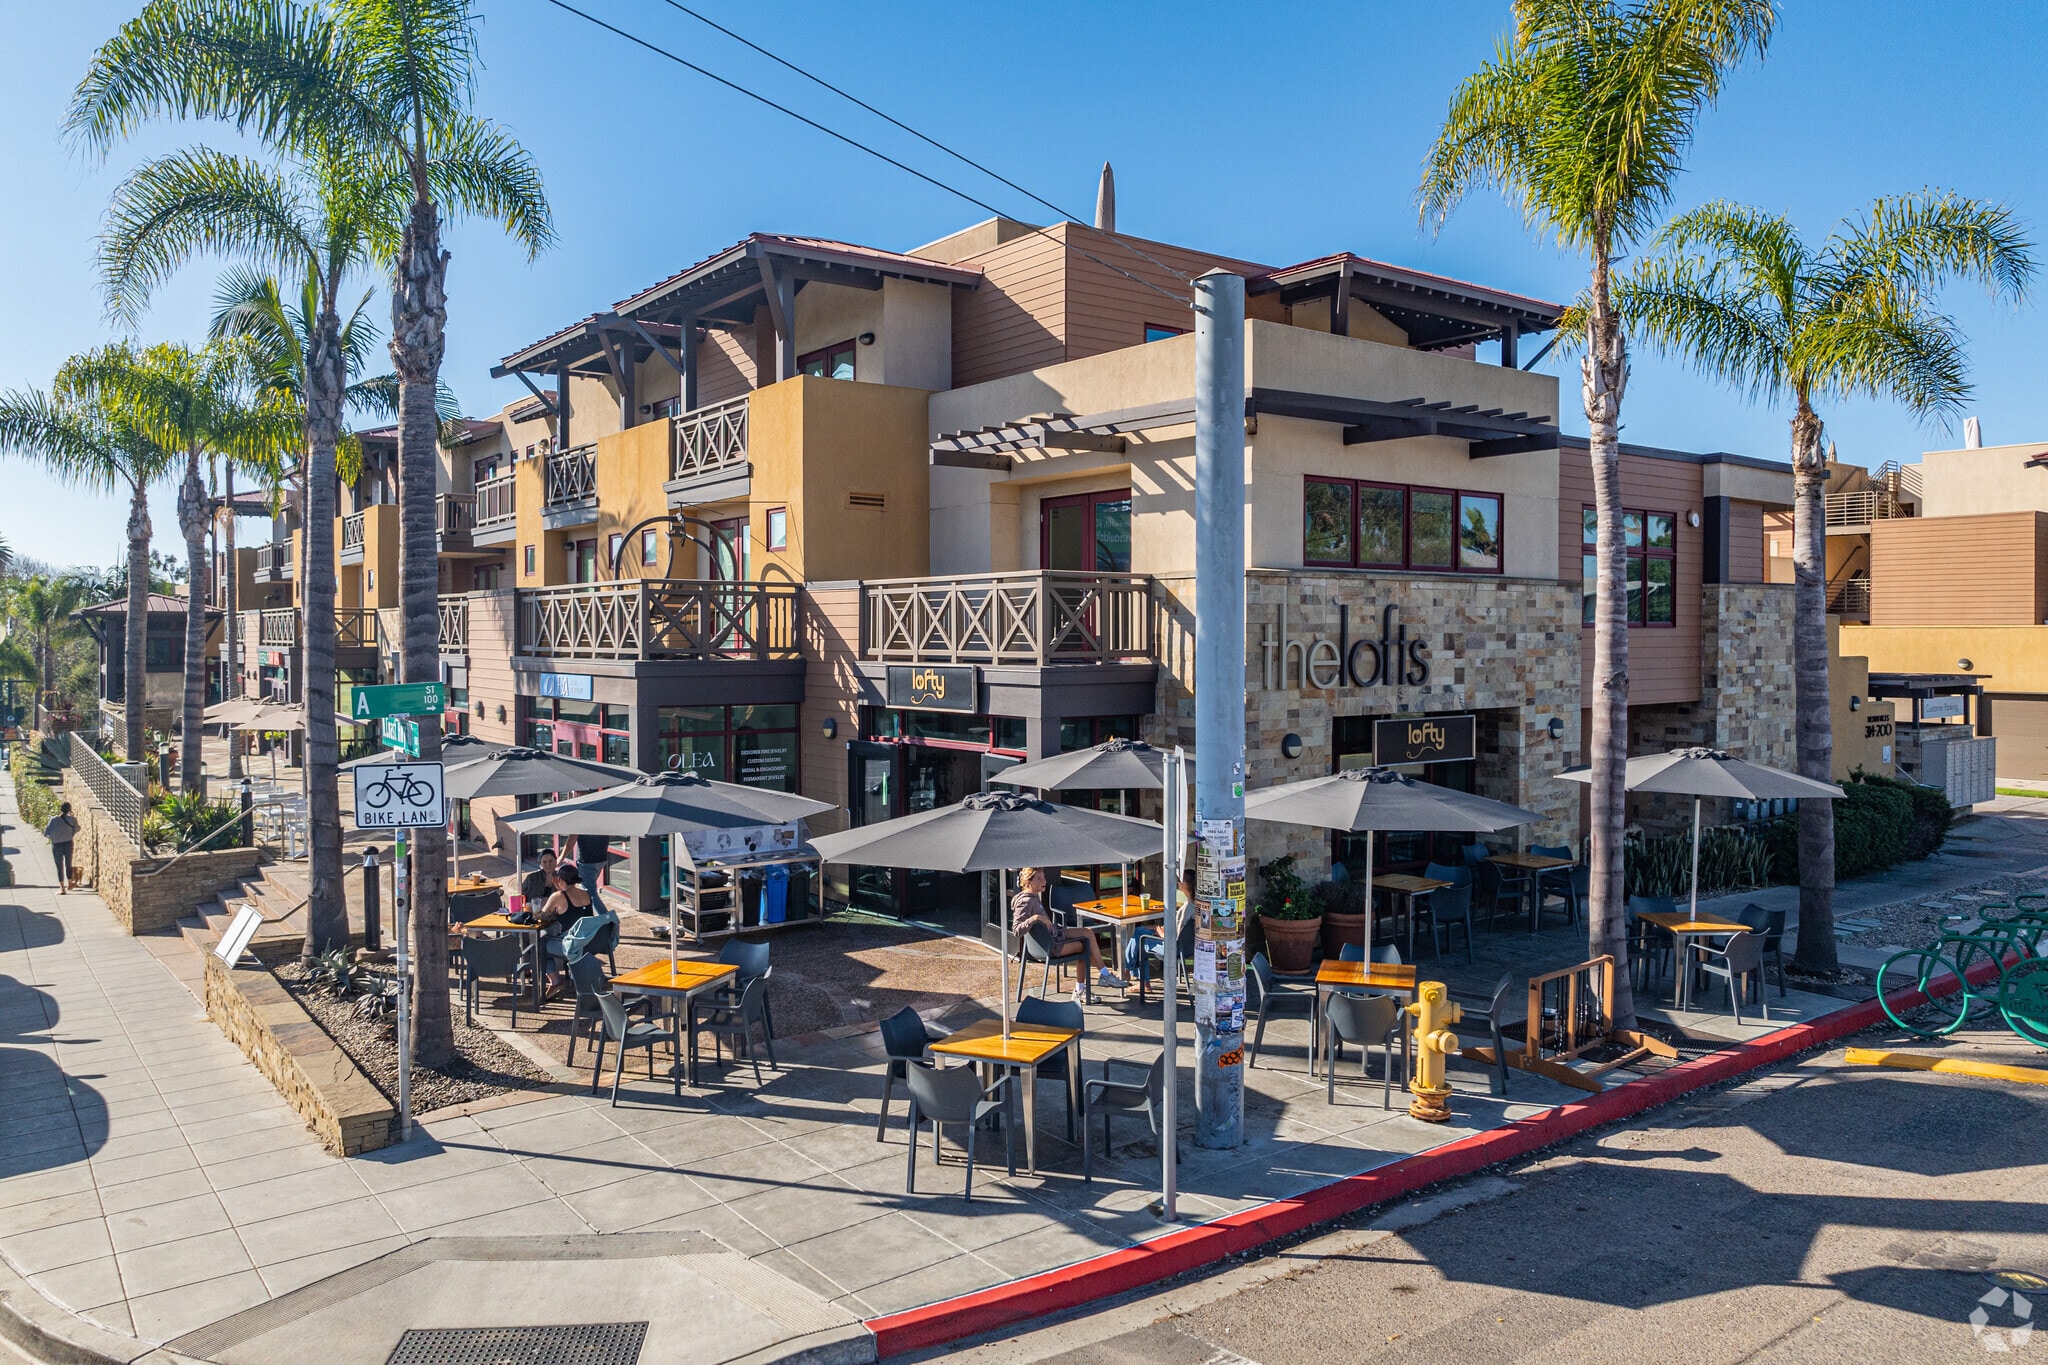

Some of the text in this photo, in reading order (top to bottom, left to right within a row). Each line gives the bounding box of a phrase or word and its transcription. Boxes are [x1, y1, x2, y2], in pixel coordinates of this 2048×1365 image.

[425, 685, 435, 694] ST
[912, 668, 945, 699] lofty
[356, 692, 370, 715] A
[424, 695, 438, 704] 100
[1408, 722, 1445, 751] lofty
[667, 752, 715, 769] OLEA
[365, 811, 436, 824] BIKE LAN
